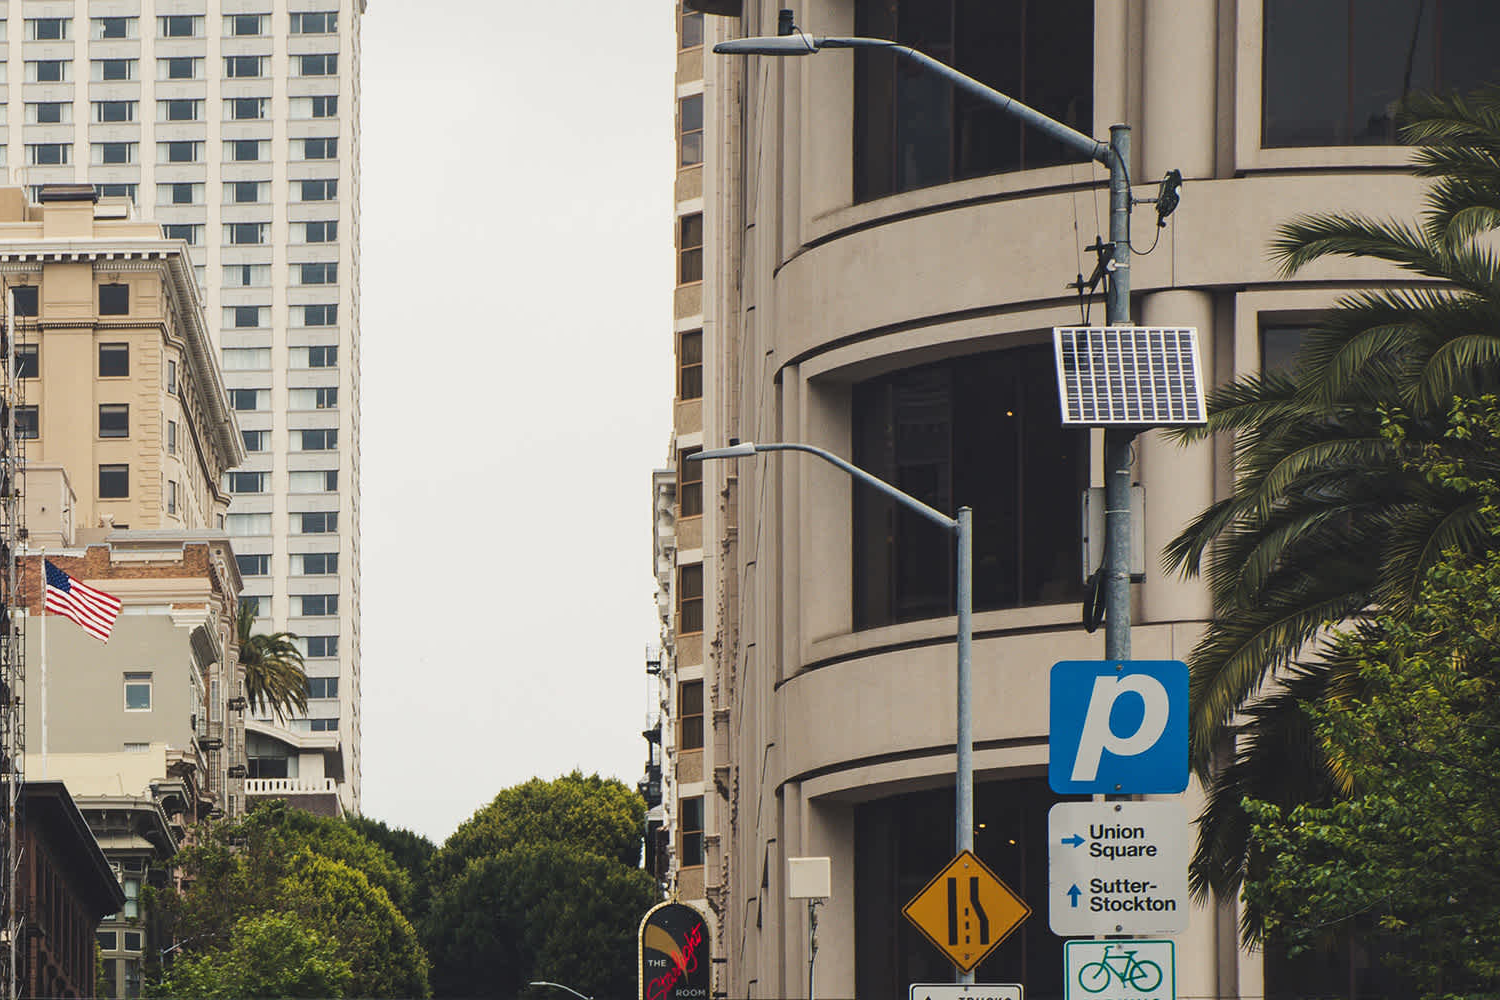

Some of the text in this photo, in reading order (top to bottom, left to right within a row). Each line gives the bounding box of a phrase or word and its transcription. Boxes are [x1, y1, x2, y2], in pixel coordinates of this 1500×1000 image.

[1090, 824, 1144, 839] Union
[1090, 842, 1157, 860] Square
[1090, 879, 1157, 894] Sutter-
[1090, 897, 1176, 912] Stockton
[648, 959, 667, 967] THE
[676, 988, 706, 997] ROOM
